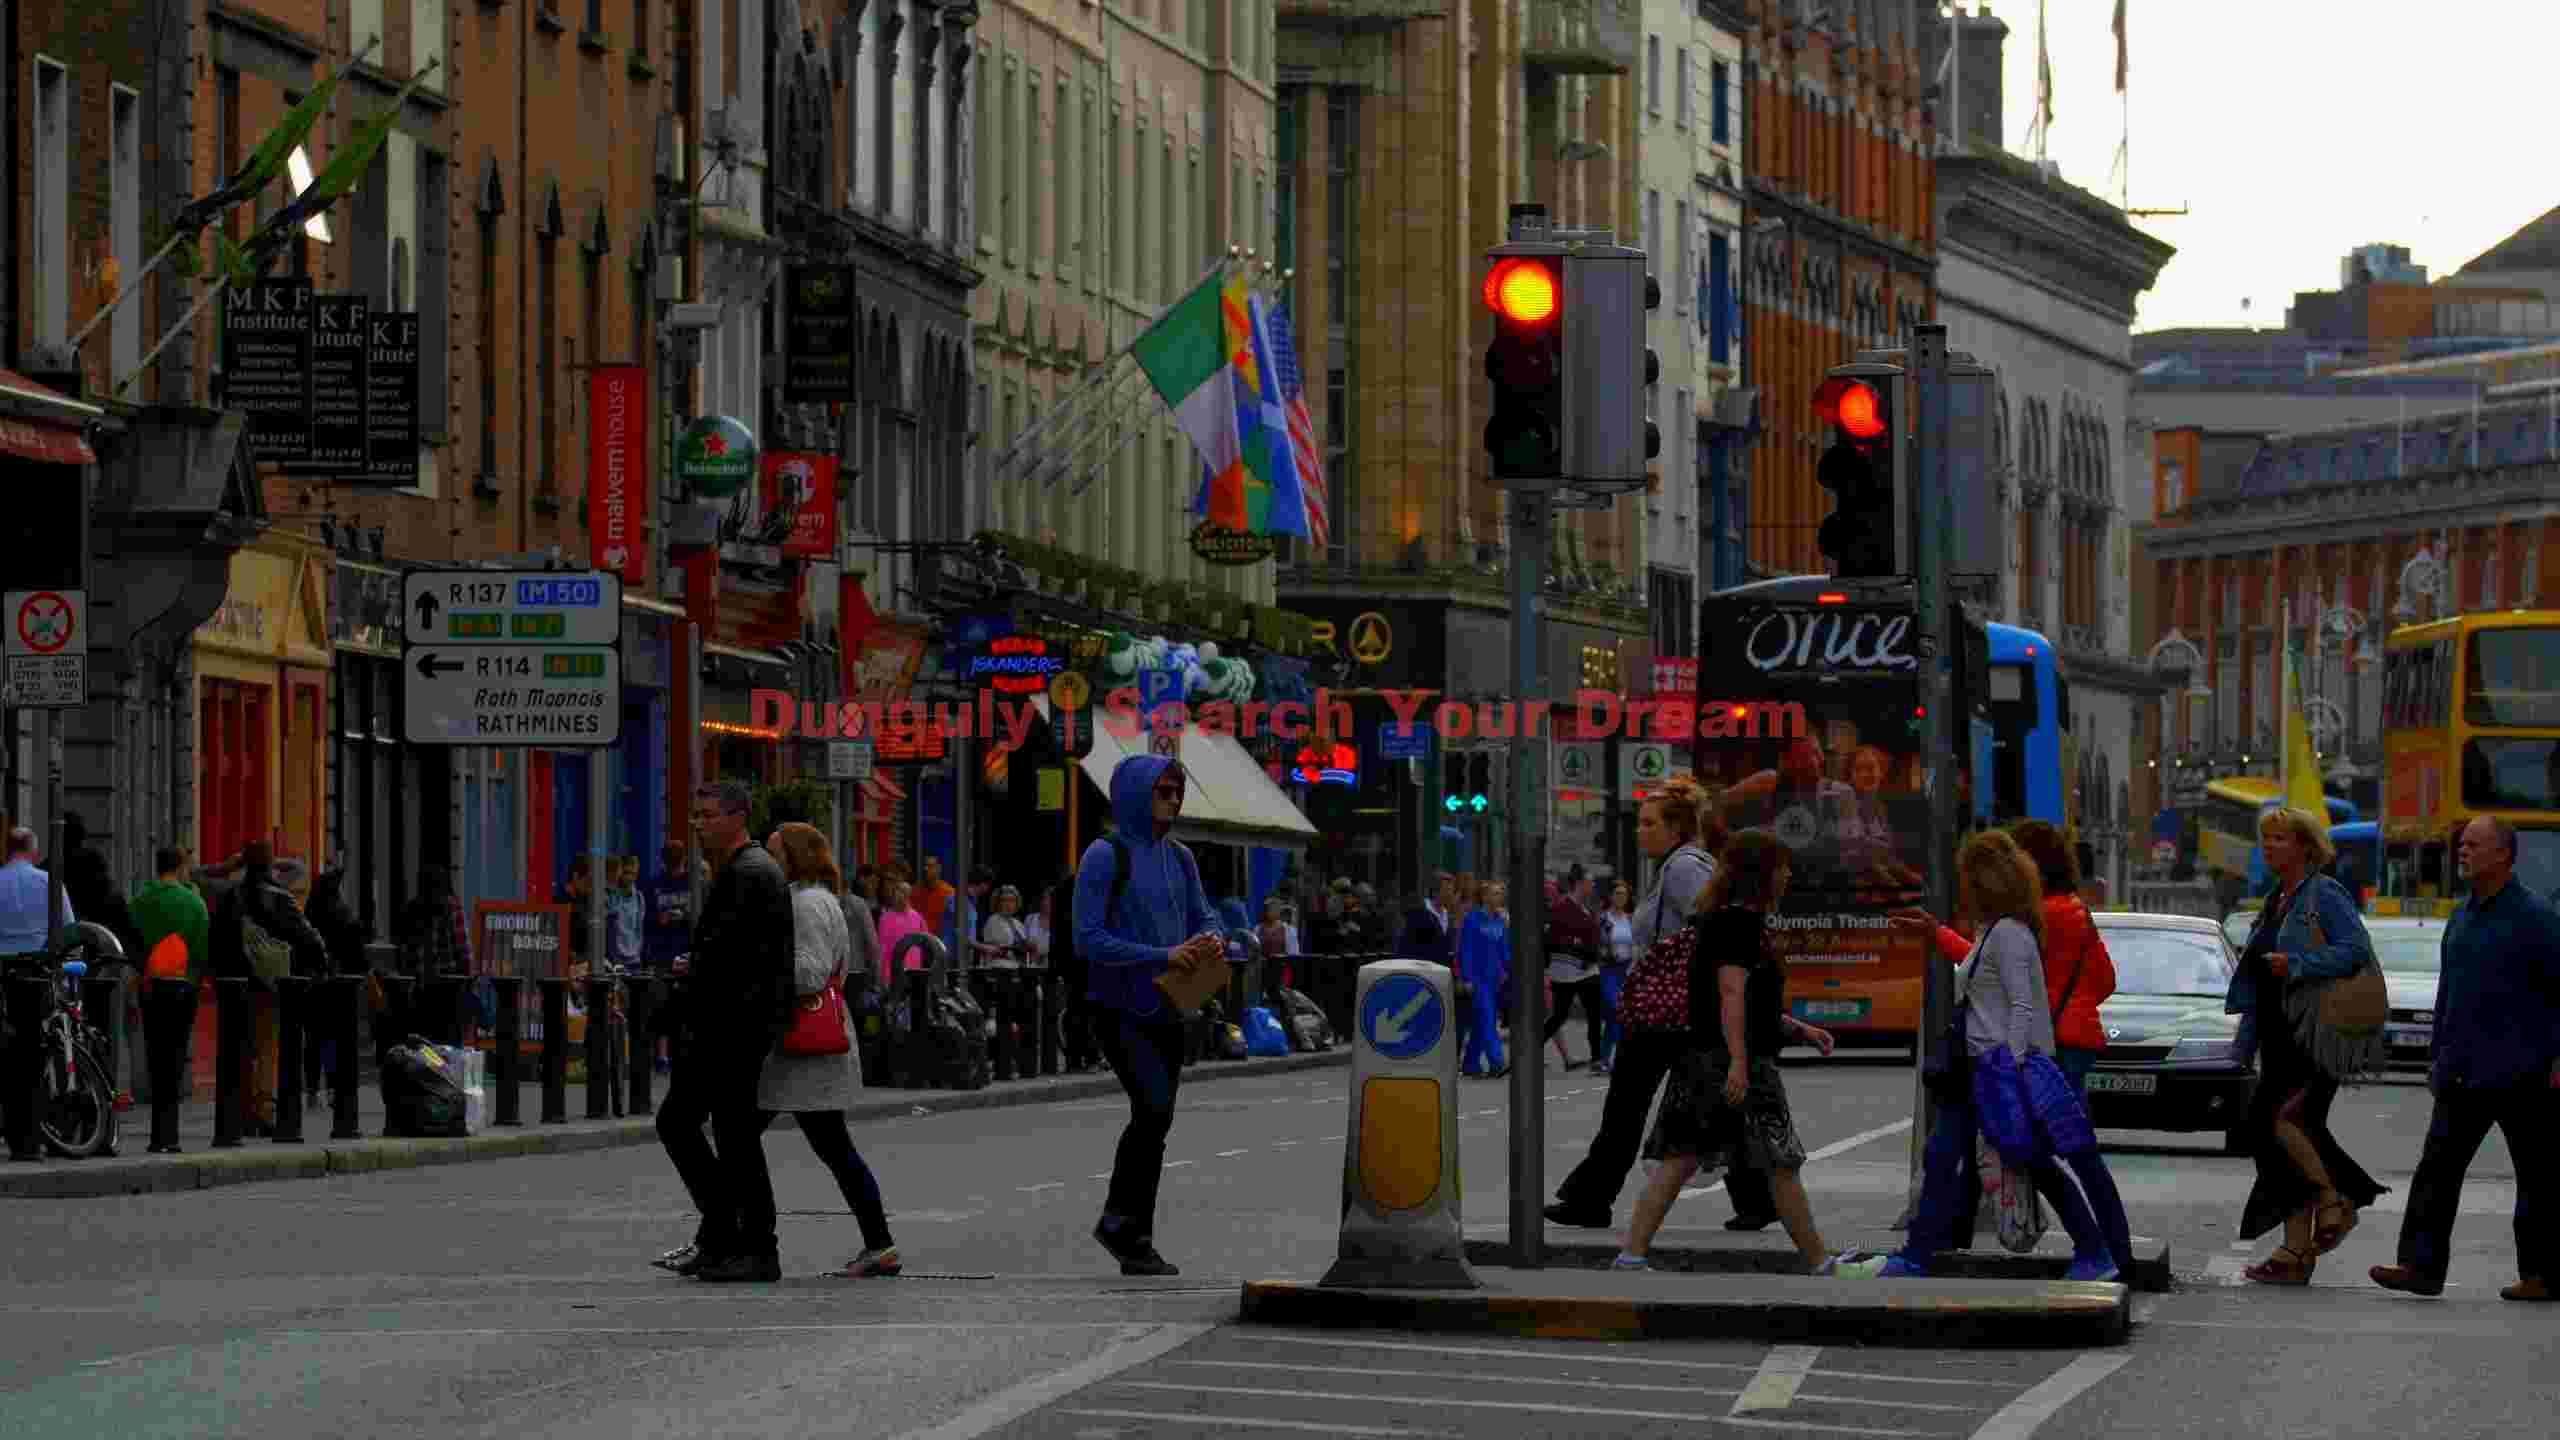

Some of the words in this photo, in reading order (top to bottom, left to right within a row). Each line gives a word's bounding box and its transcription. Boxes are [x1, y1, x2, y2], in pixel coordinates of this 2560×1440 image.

[225, 311, 310, 330] Institute
[476, 713, 600, 734] RATHMINES
[1764, 911, 1833, 930] Olympia
